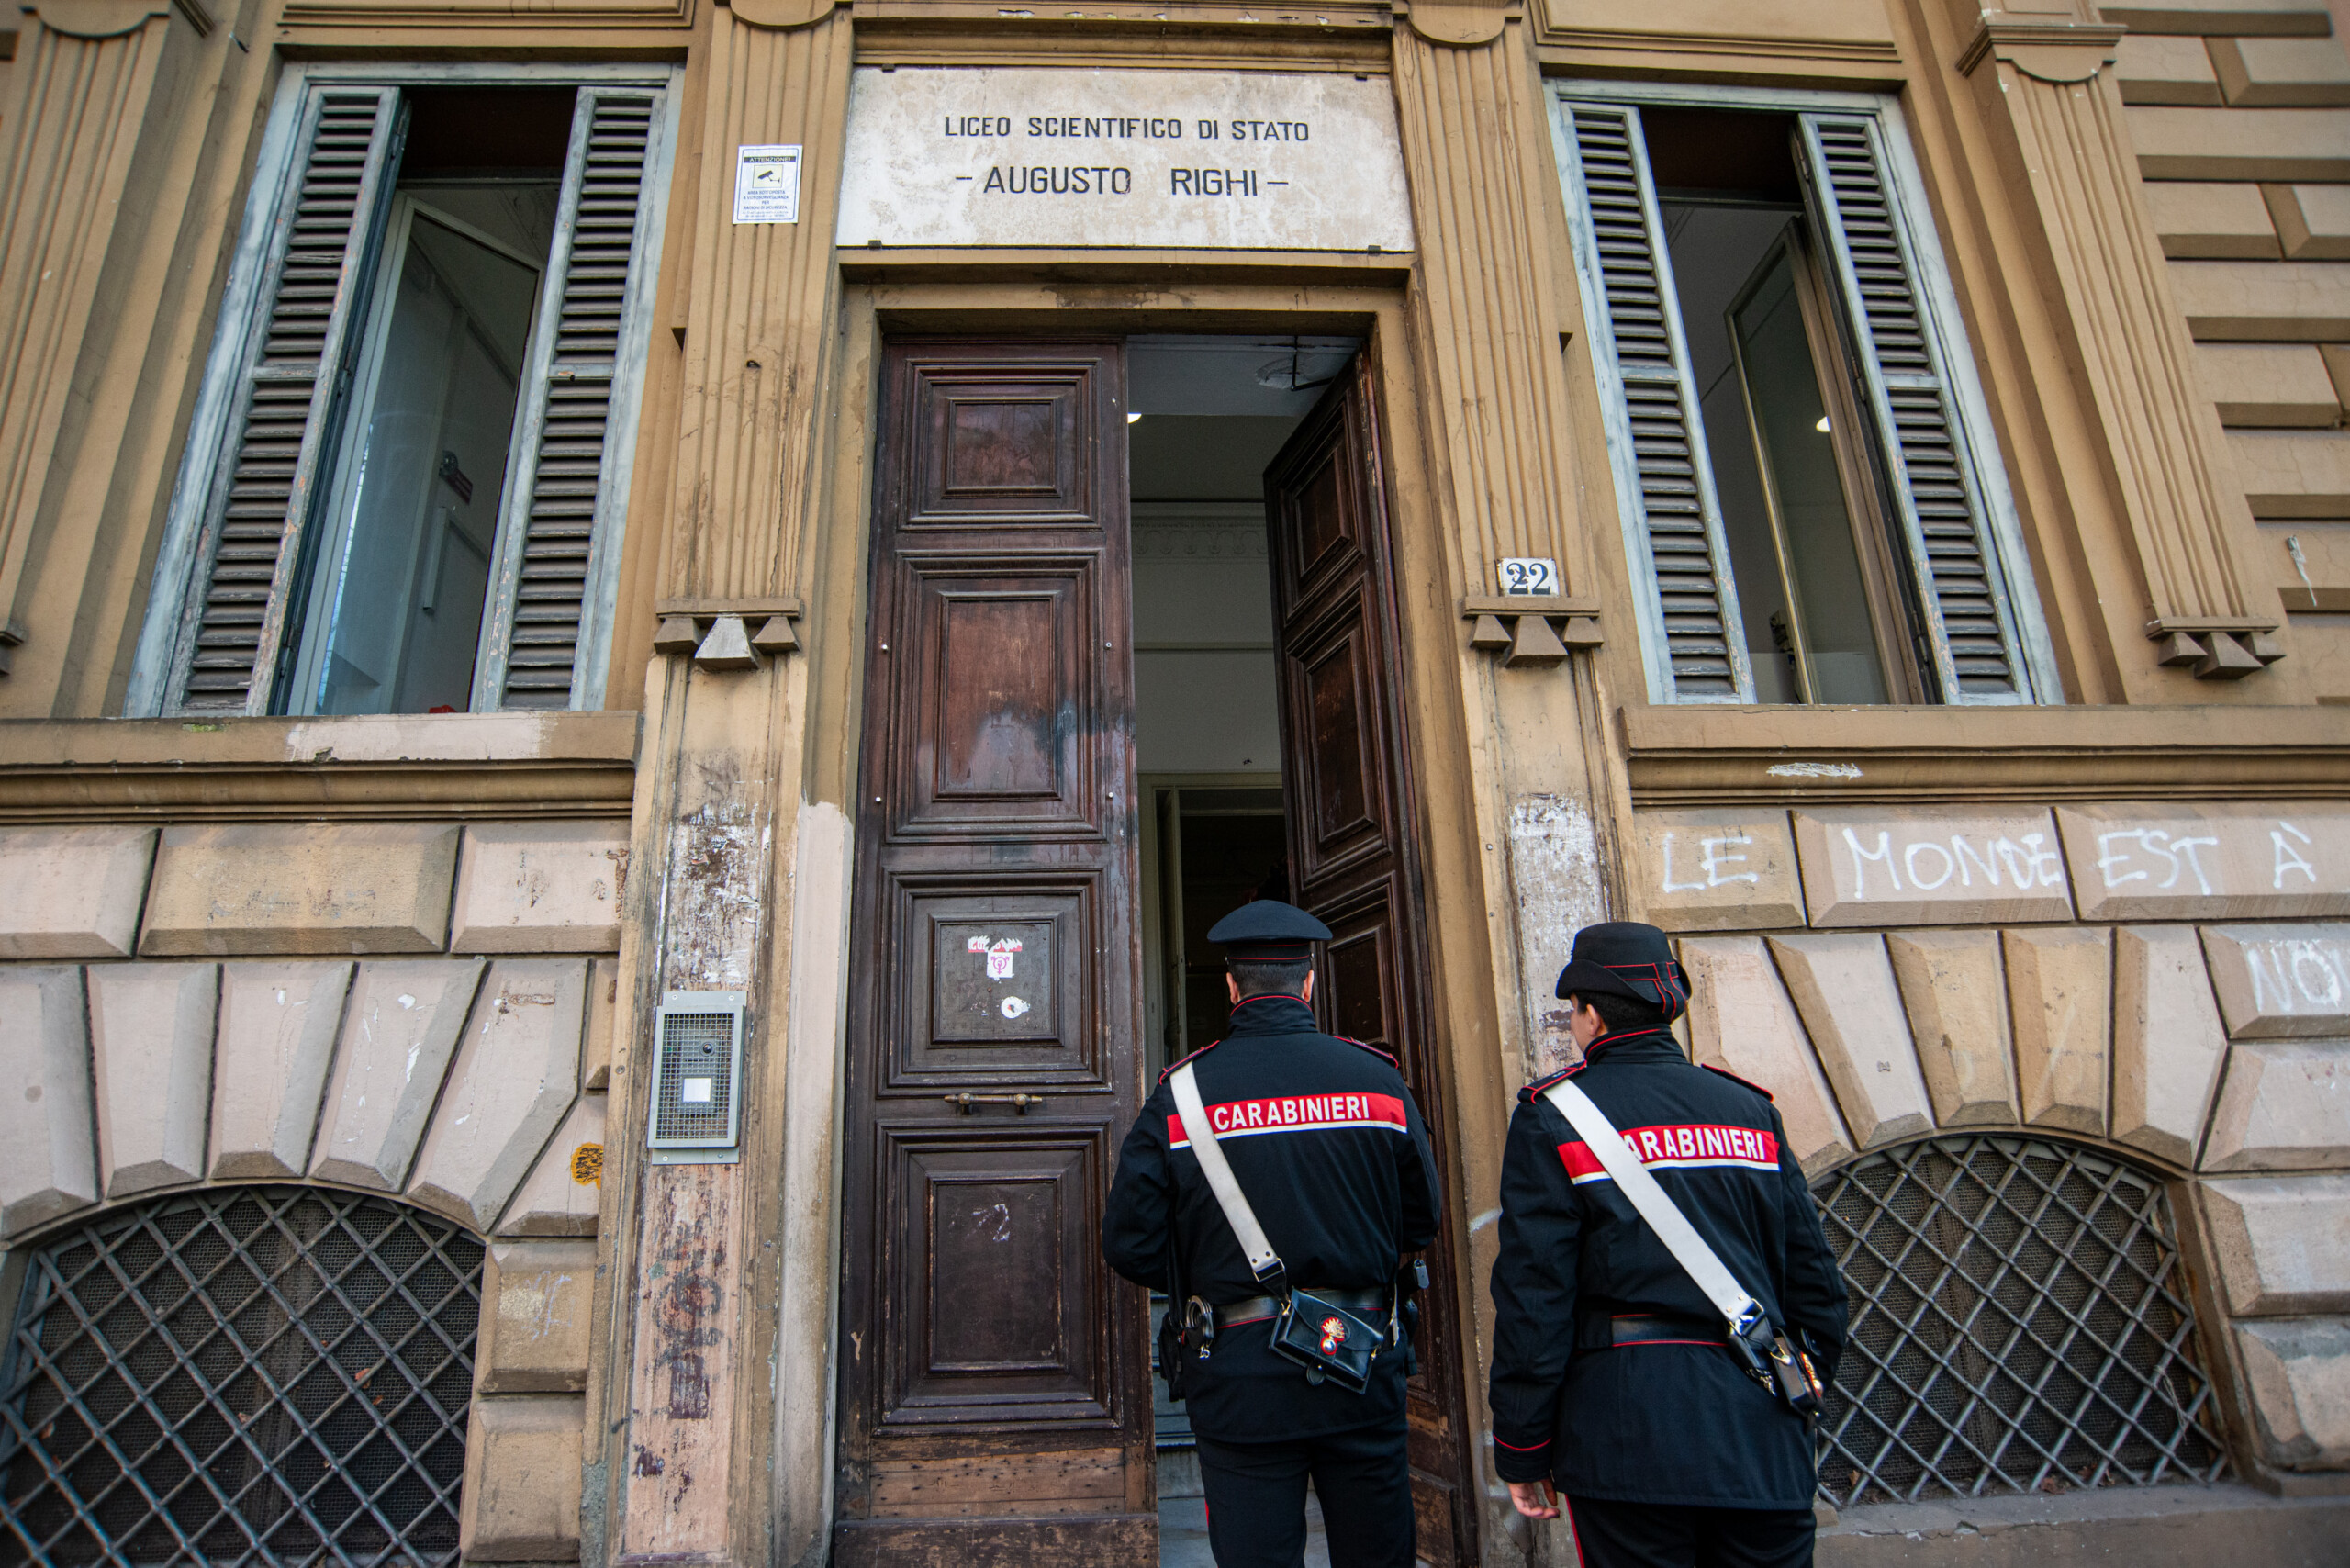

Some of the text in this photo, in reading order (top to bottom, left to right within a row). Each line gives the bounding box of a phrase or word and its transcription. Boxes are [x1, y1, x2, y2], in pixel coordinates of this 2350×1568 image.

[945, 116, 1309, 141] LICEO SCIENTIFICO DI STATO
[983, 166, 1131, 195] AUGUSTO
[1170, 168, 1258, 196] RIGHI
[1506, 562, 1550, 595] 22
[1662, 831, 1758, 894] LE
[1841, 827, 2063, 899] MONDE
[2098, 827, 2219, 896] EST
[1214, 1095, 1370, 1131] CARABINIERI
[1623, 1127, 1766, 1161] ARABINIERI
